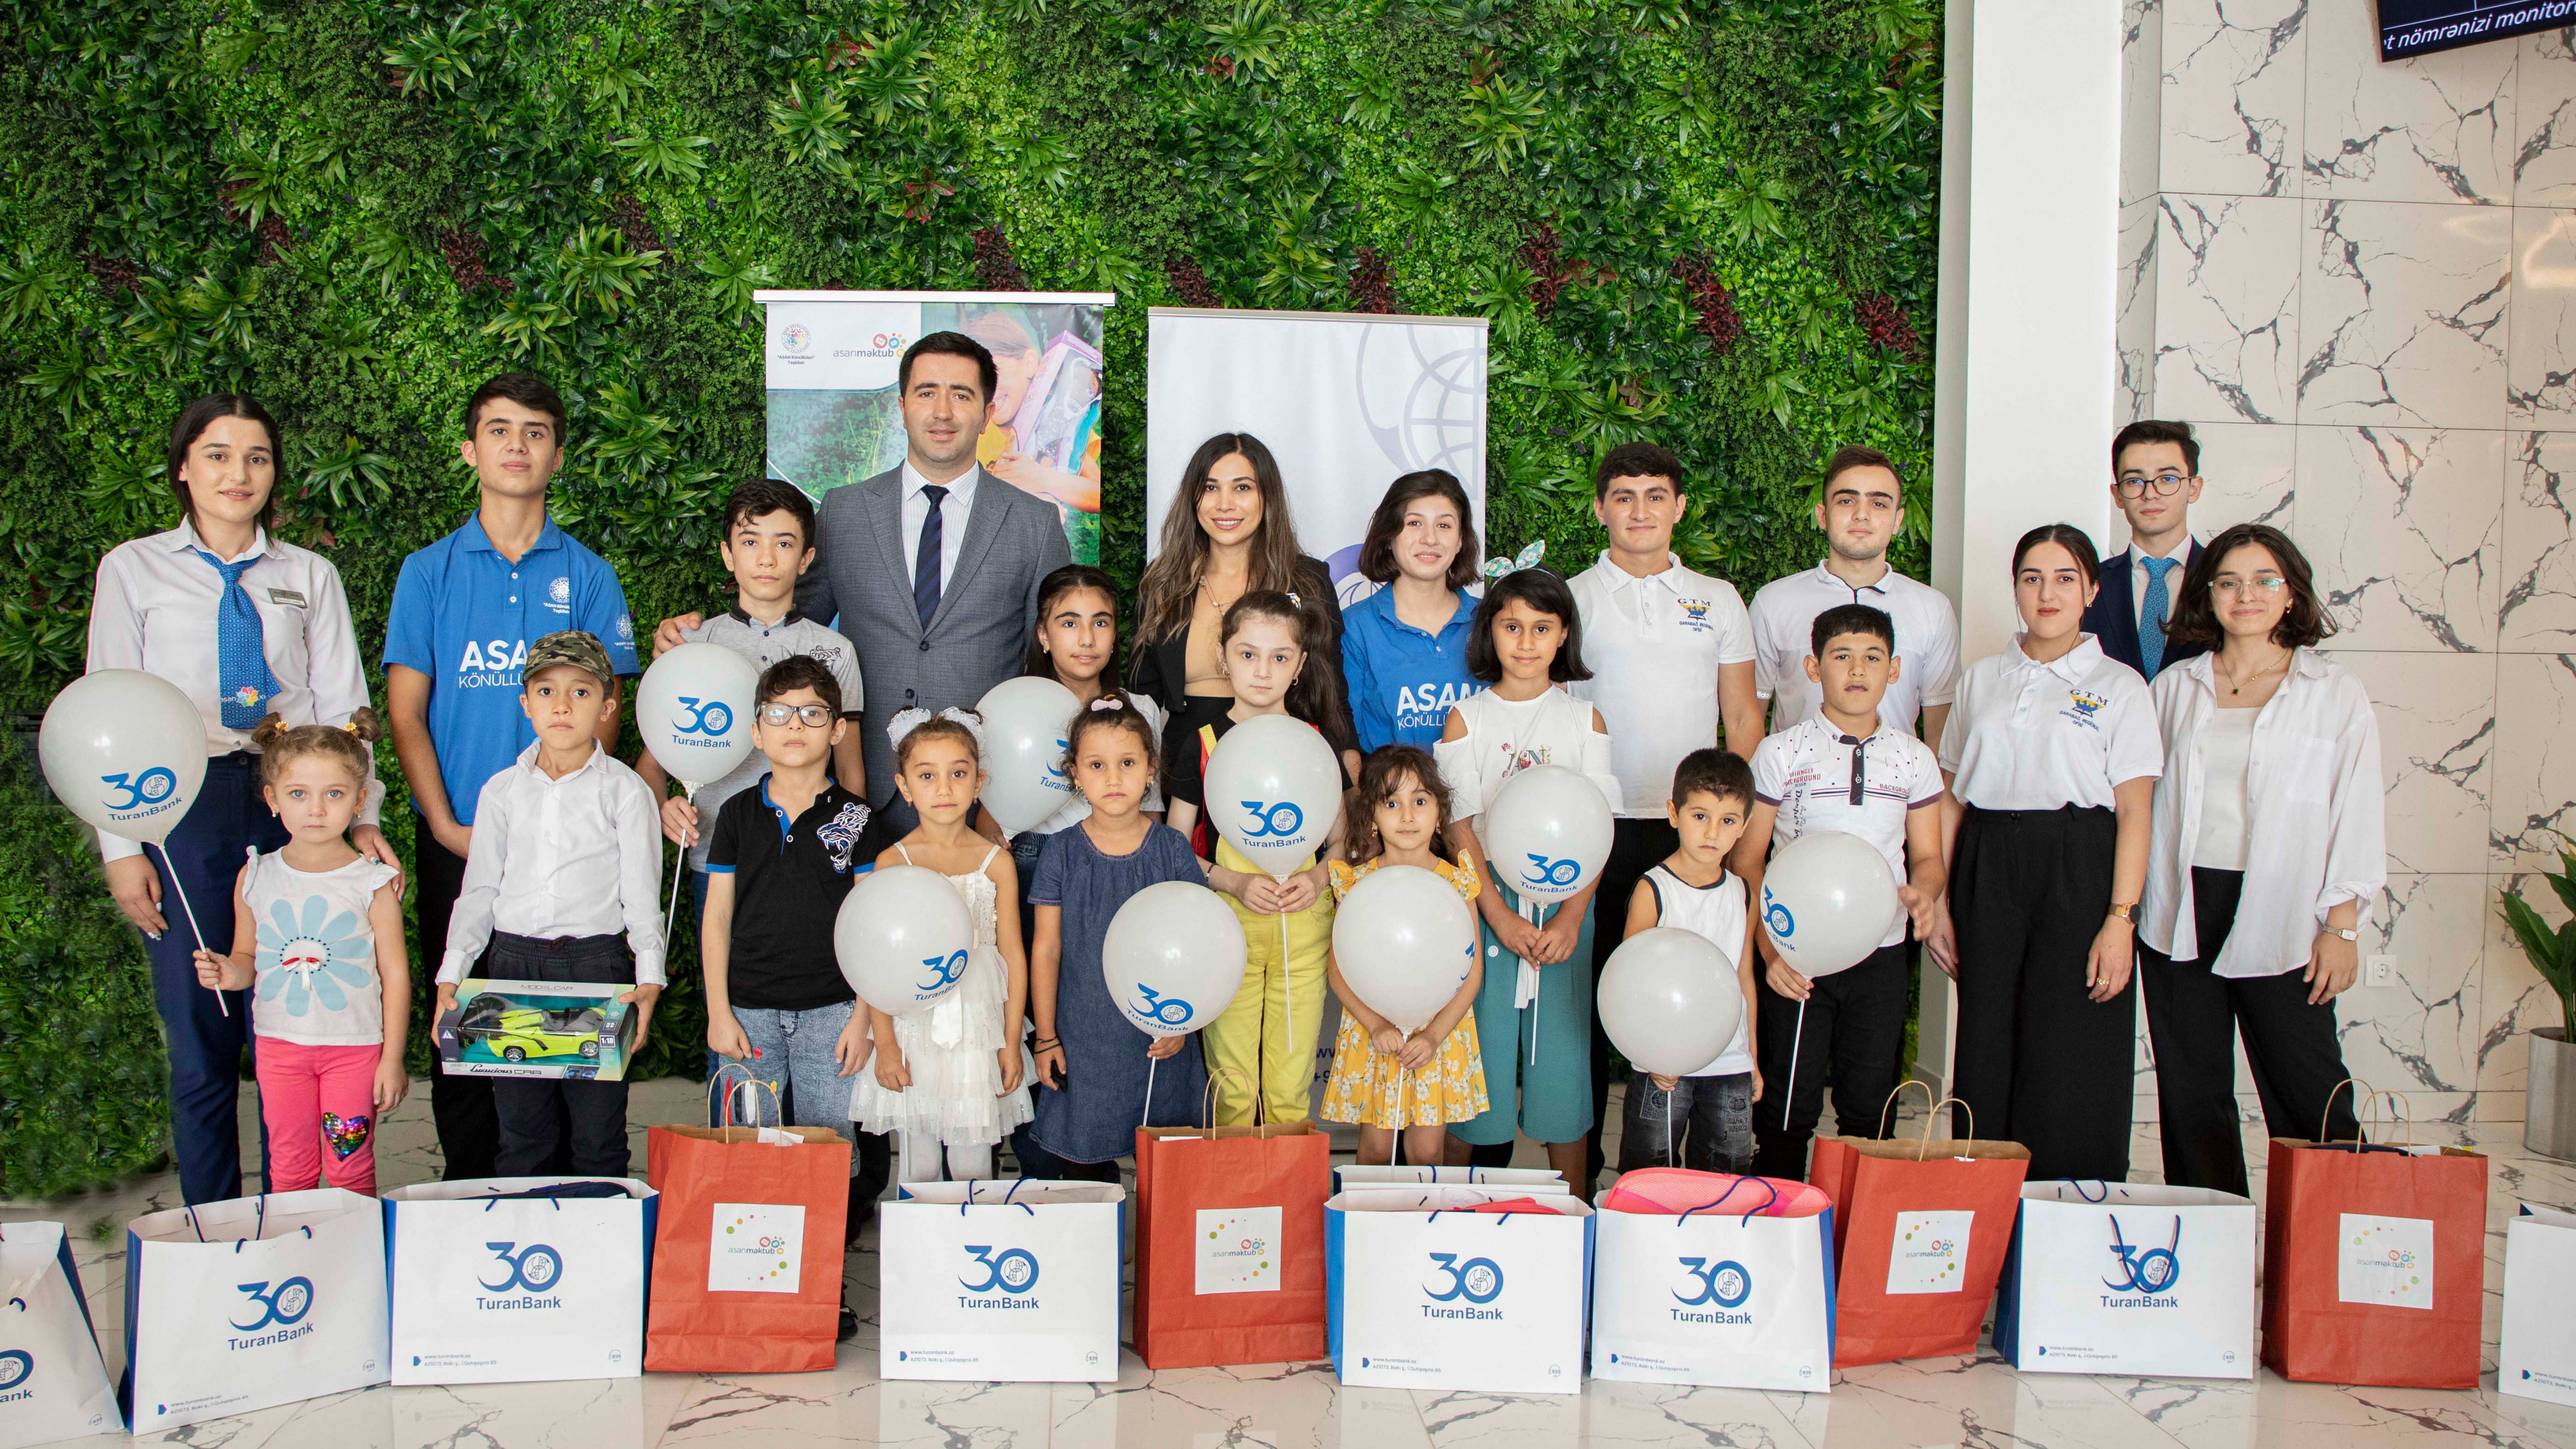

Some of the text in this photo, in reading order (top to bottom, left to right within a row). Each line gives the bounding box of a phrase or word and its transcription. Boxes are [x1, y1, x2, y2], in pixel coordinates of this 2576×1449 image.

[2384, 35, 2396, 50] t
[2398, 14, 2492, 48] nömrənizi
[459, 640, 527, 672] ASA
[671, 696, 733, 737] 30
[672, 735, 731, 748] TuranBank
[101, 766, 177, 810] 30
[1041, 776, 1072, 792] TuranB
[107, 796, 183, 822] TuranBank
[1238, 801, 1303, 837] 30
[1241, 835, 1306, 849] TuranBank
[1520, 853, 1581, 886] 30
[1520, 881, 1578, 893] TuranBank
[916, 949, 968, 991] 30
[1127, 982, 1194, 1025] 30
[1125, 1008, 1190, 1033] TuranBank
[477, 1242, 563, 1292] 30
[958, 1245, 1039, 1293] 30
[1422, 1253, 1504, 1304] 30
[1671, 1257, 1751, 1308] 30
[228, 1276, 314, 1331] 30
[476, 1296, 561, 1310] TuranBank
[958, 1296, 1040, 1309] TuranBank
[1421, 1305, 1503, 1320] TuranBank
[1670, 1309, 1752, 1324] TuranBank
[2100, 1296, 2178, 1308] TuranBank
[228, 1322, 314, 1351] TuranBank
